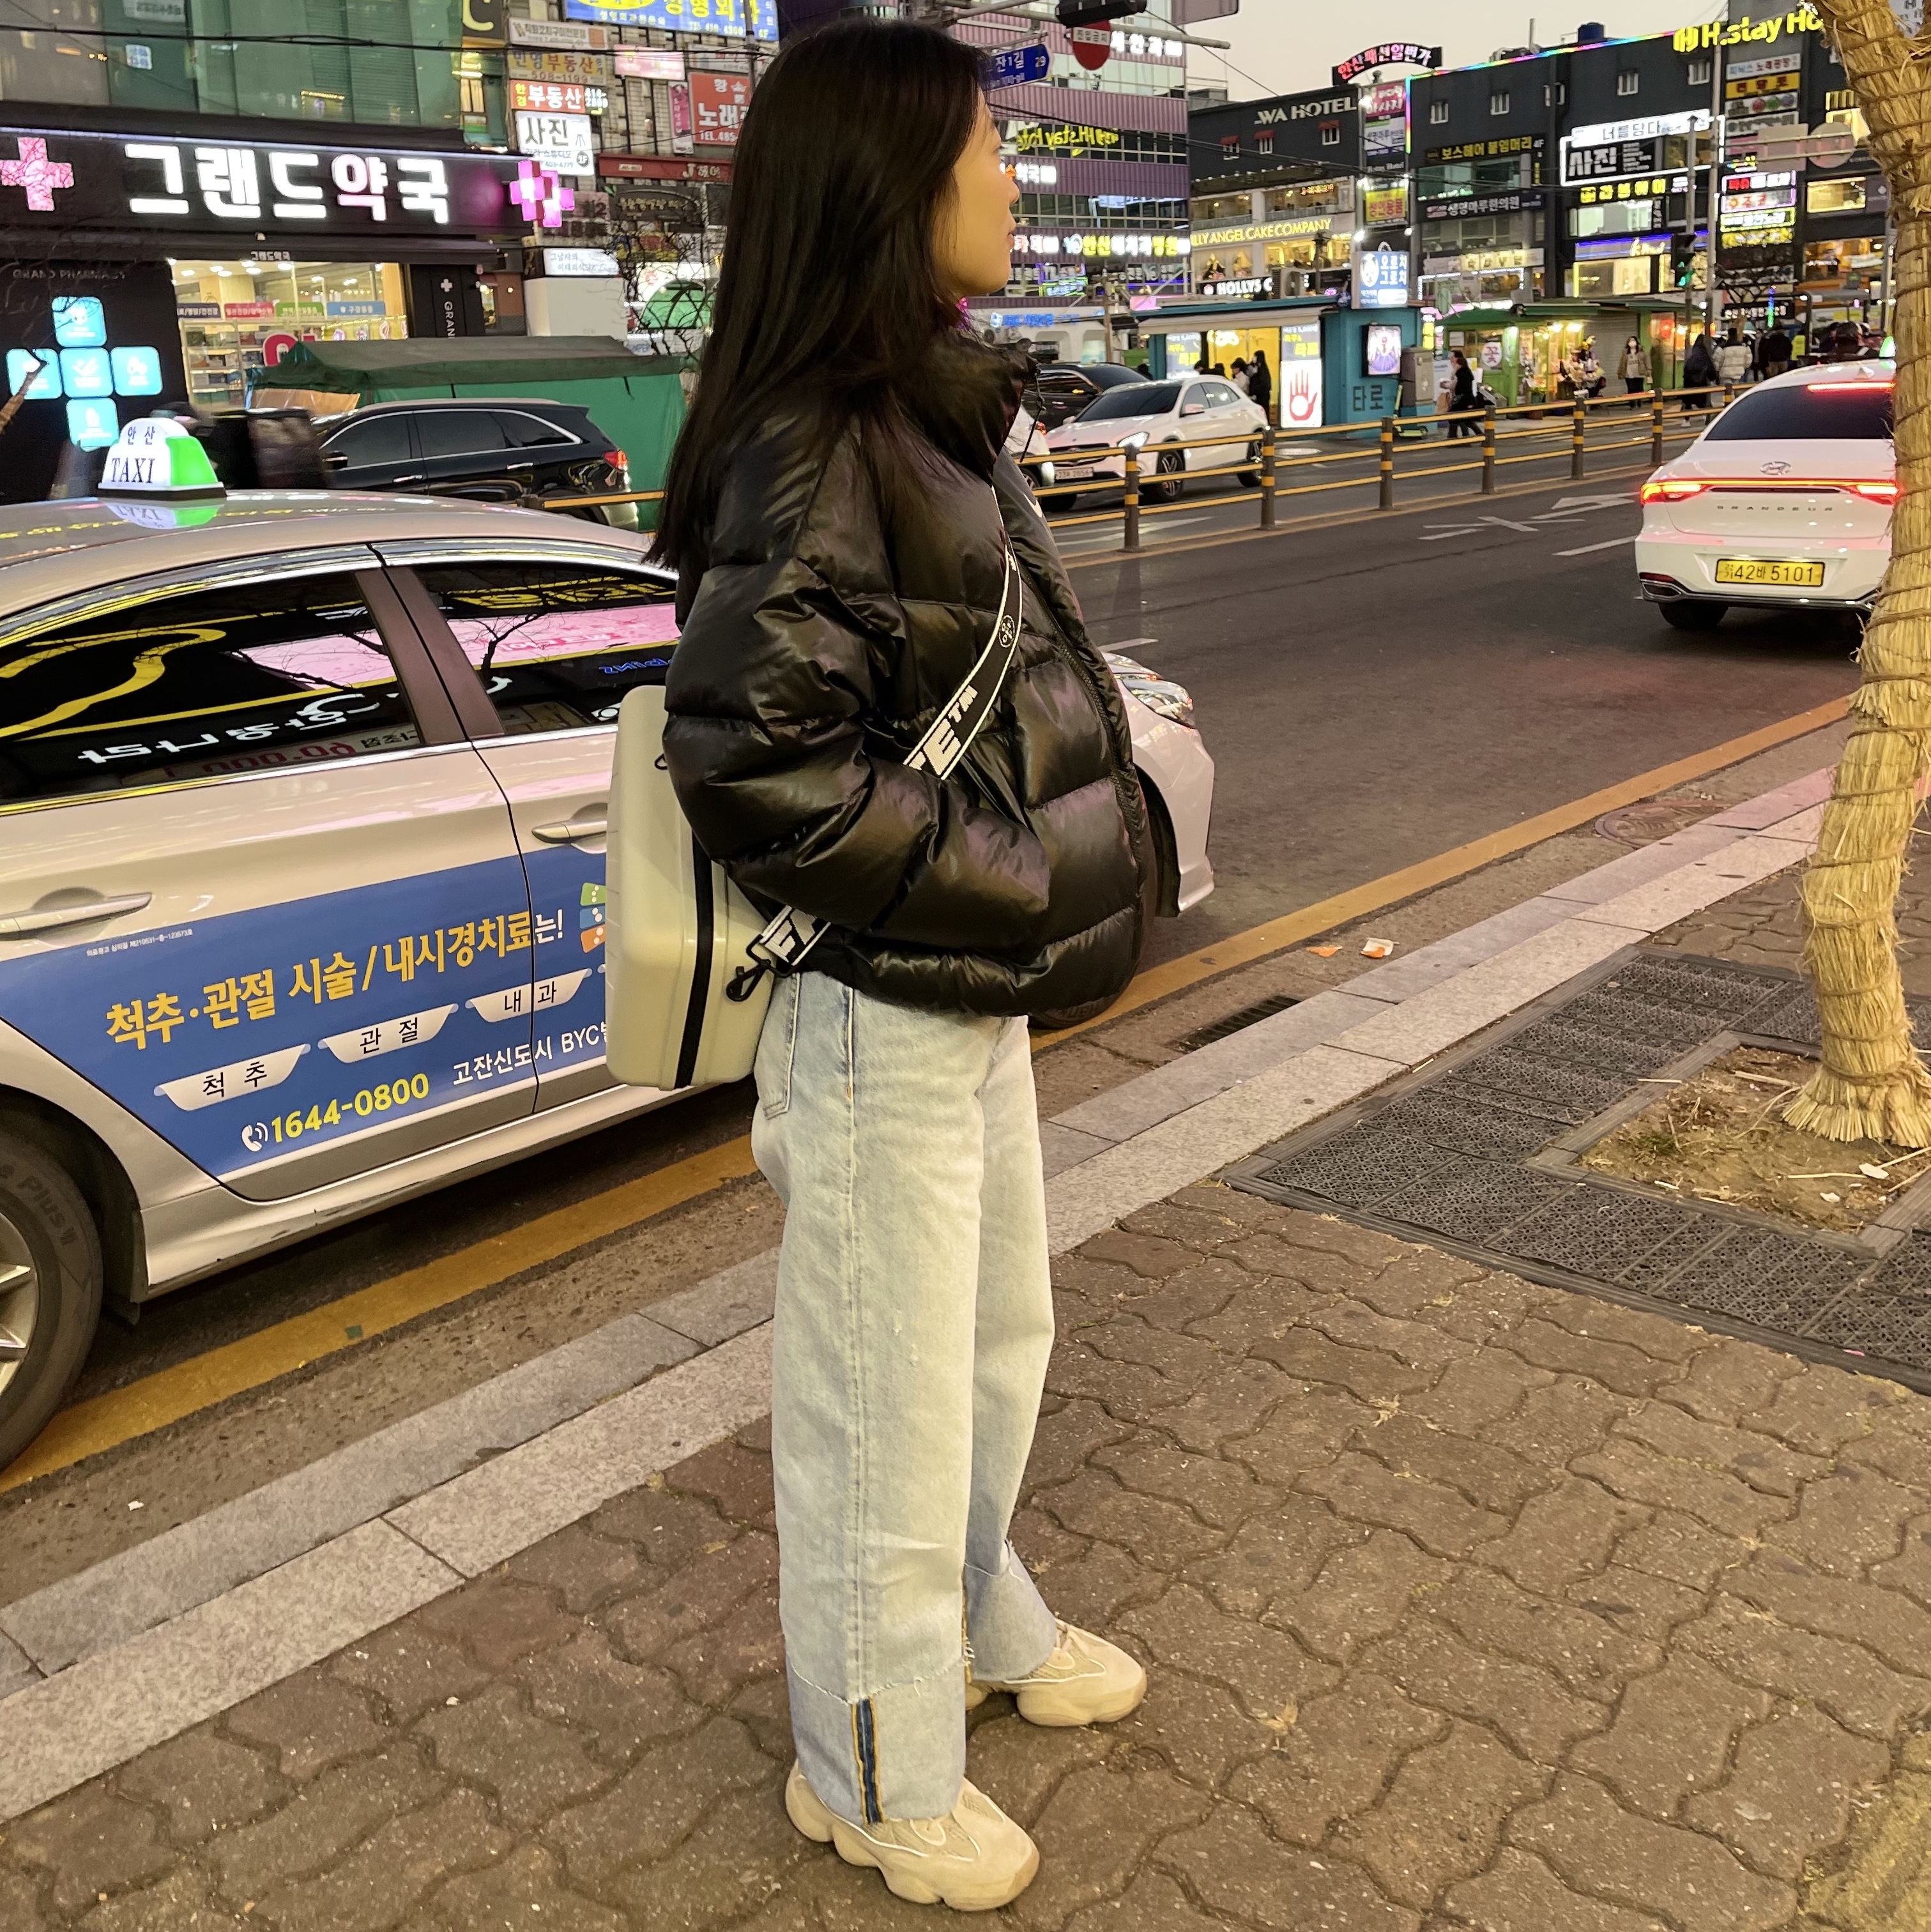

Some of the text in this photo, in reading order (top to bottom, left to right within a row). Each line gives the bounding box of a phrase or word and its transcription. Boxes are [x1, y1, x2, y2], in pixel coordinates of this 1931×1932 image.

[528, 84, 582, 109] 부동산
[1257, 96, 1357, 125] WA HOTEL
[525, 117, 569, 146] 사진
[1568, 147, 1617, 177] 사진
[125, 143, 449, 224] 그랜드약국
[1191, 218, 1332, 247] ILLY ANGEL CAKE COMPANY
[1217, 280, 1263, 295] HOLLYS
[444, 301, 455, 339] GRAN
[1352, 384, 1384, 412] 타로
[111, 457, 156, 484] TAXI
[1771, 565, 1813, 583] 5101
[271, 1021, 607, 1144] 1644-0800 고잔신도시 BYC
